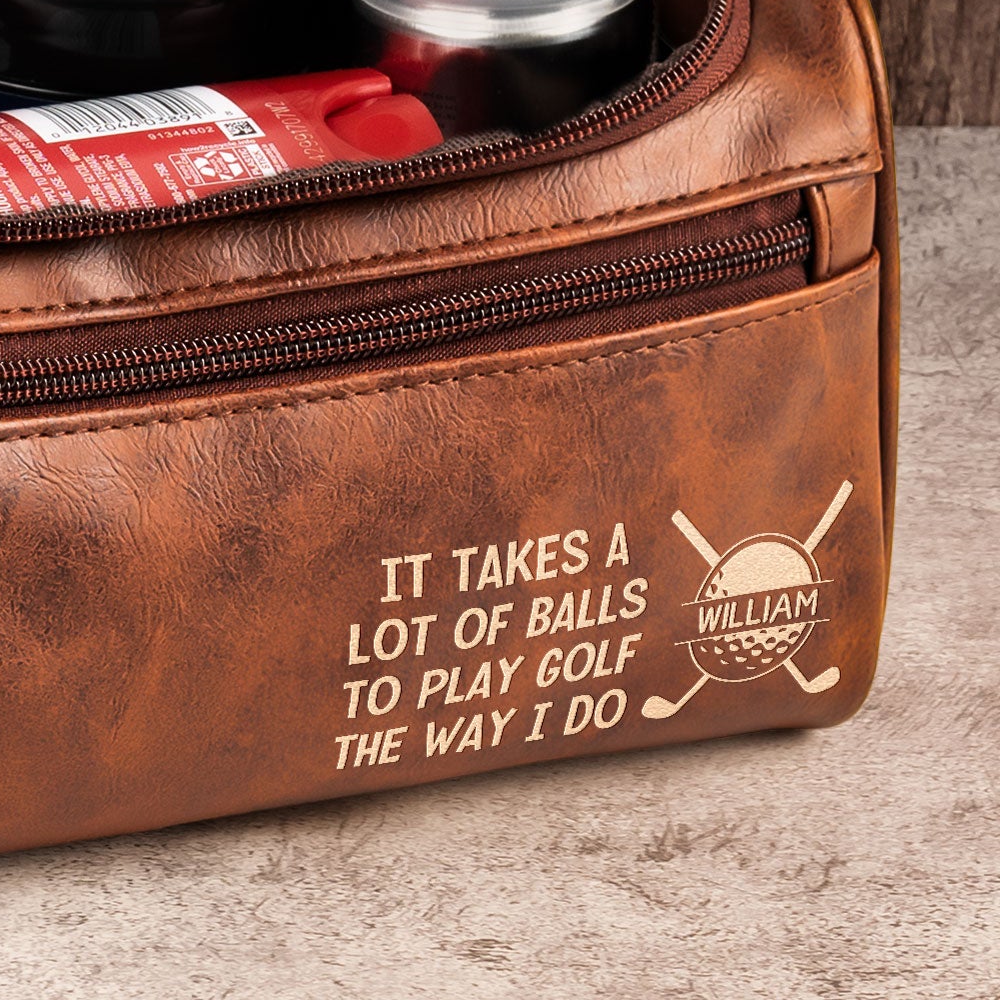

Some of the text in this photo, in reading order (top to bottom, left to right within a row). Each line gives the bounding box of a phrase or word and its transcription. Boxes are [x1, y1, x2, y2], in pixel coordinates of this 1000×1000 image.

[381, 523, 628, 602] IT TAKES A
[349, 578, 648, 665] LOT OF BALLS
[699, 589, 818, 633] WILLIAM
[344, 633, 642, 718] TO PLAY GOLF
[335, 689, 627, 769] THE WAY I DO
